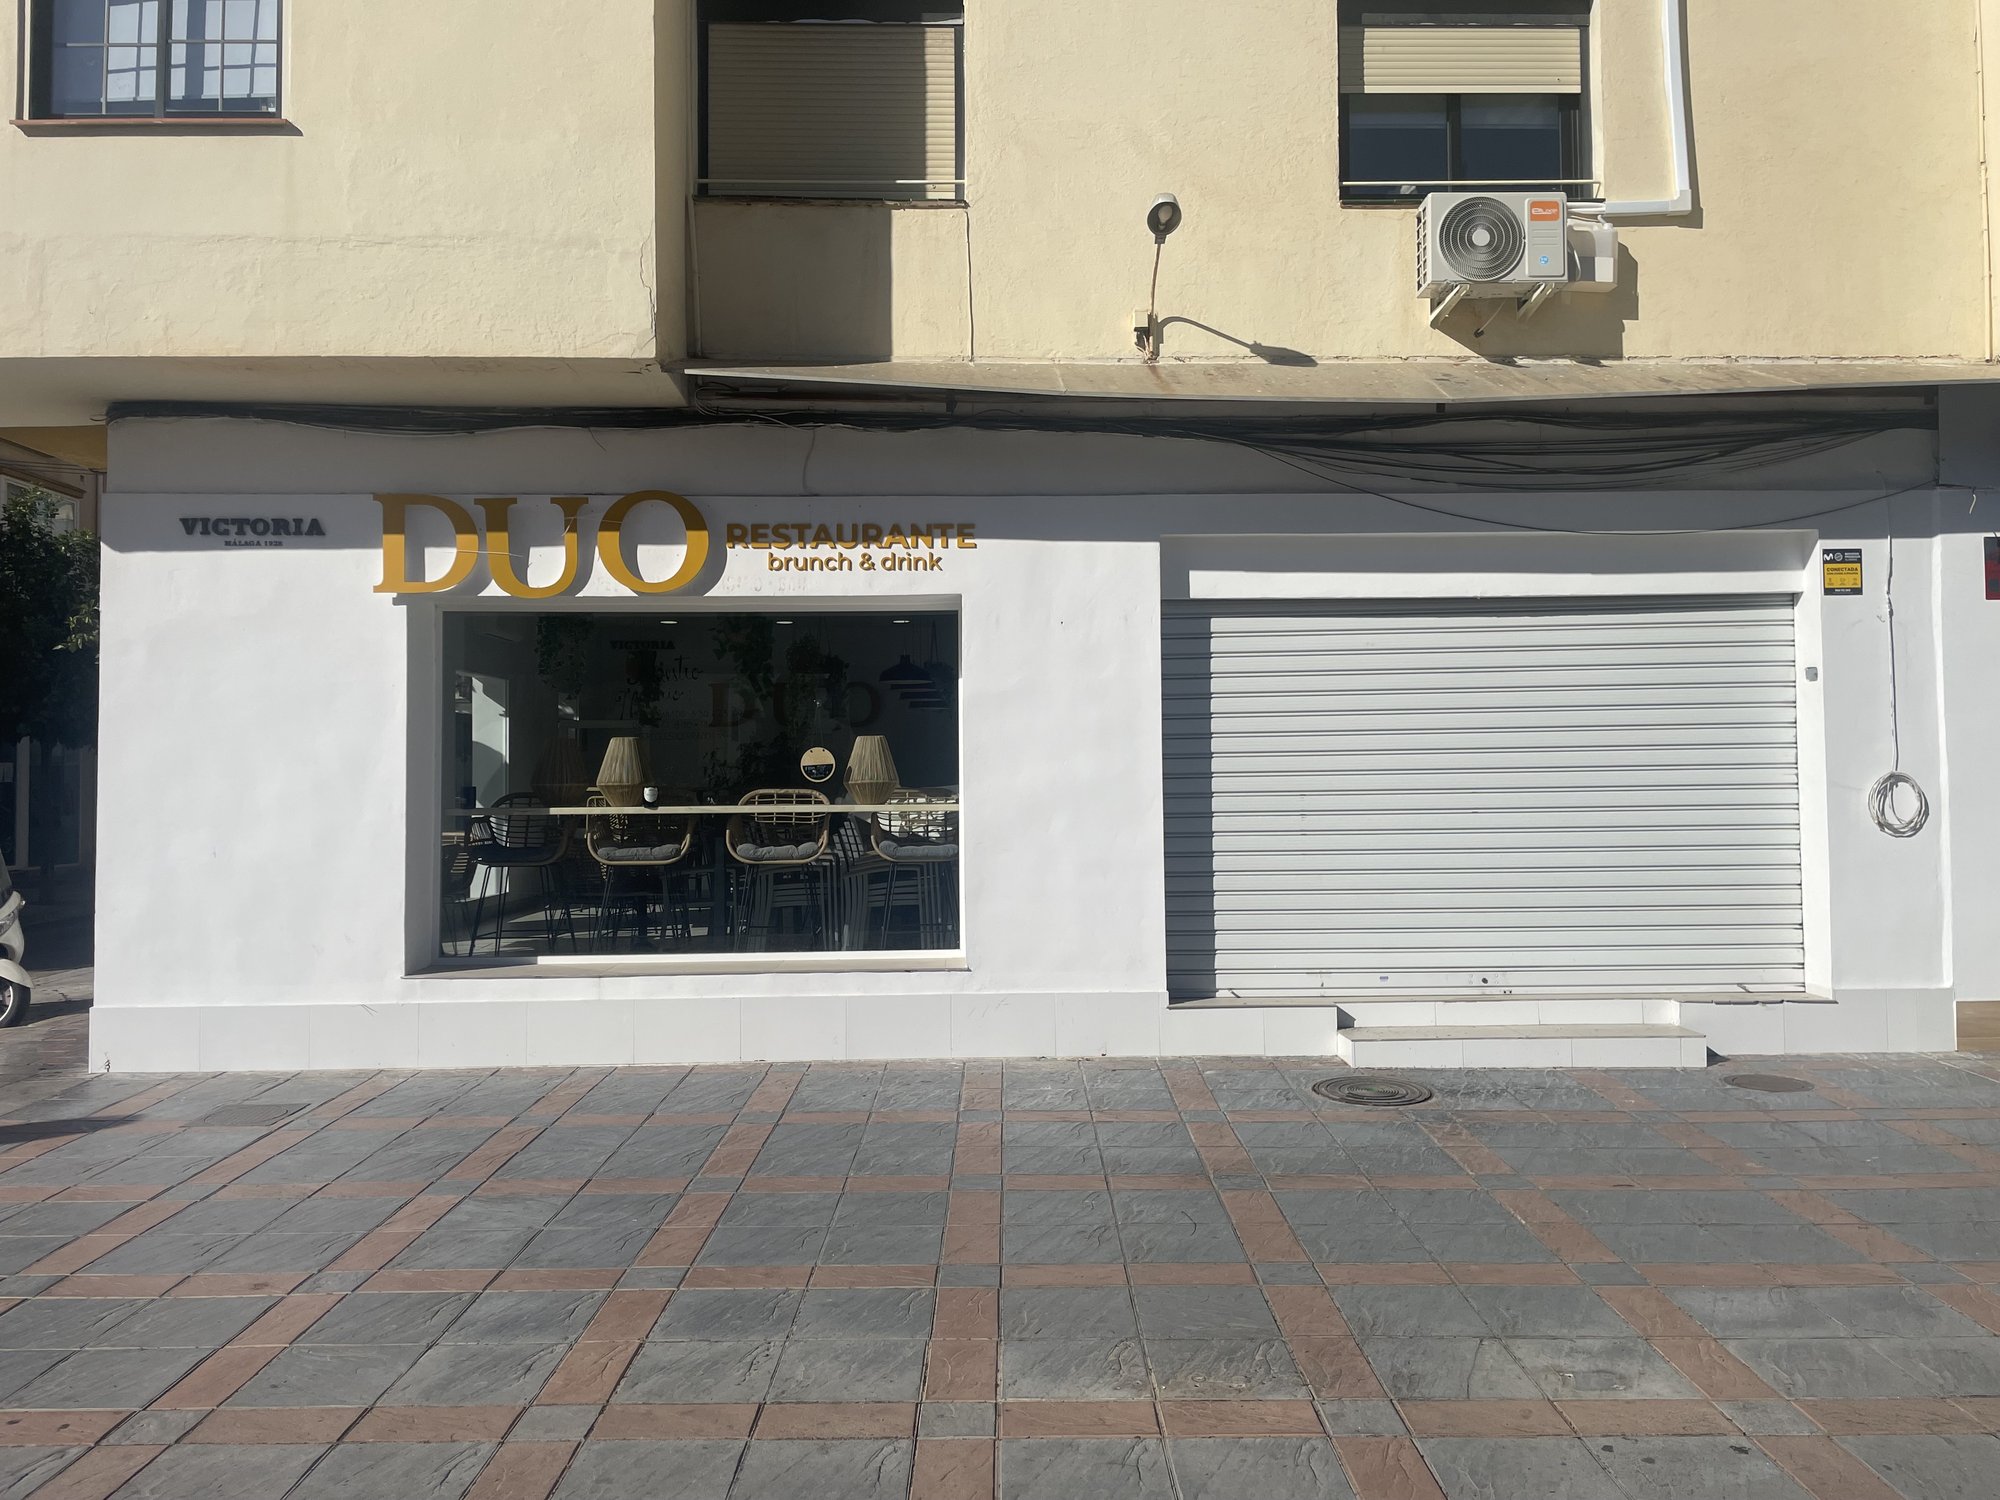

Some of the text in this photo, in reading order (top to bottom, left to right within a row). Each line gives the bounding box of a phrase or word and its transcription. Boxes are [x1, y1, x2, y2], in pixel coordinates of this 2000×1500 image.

[179, 517, 326, 536] VICTORIA
[726, 523, 977, 549] RESTAURANTE
[224, 538, 261, 547] MÁLAGA
[372, 489, 711, 599] DUO
[768, 552, 943, 571] brunch & drink
[609, 640, 676, 650] VICTORIA
